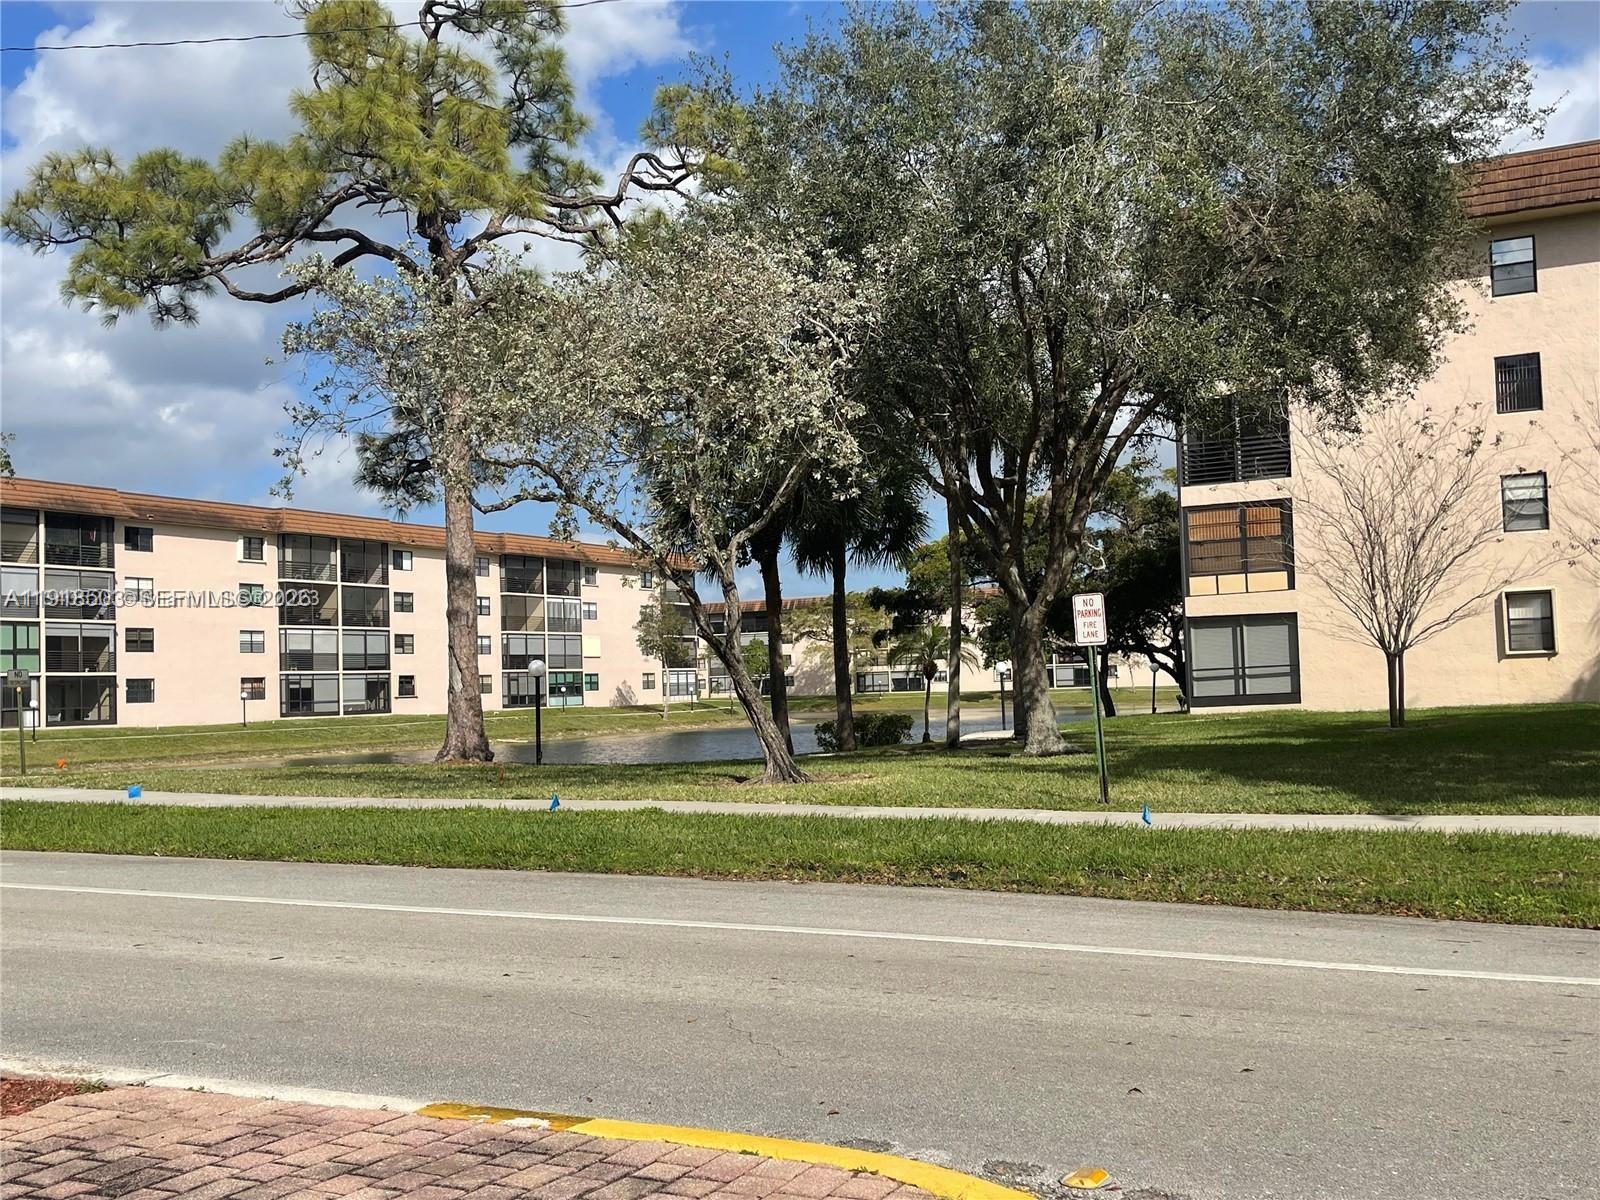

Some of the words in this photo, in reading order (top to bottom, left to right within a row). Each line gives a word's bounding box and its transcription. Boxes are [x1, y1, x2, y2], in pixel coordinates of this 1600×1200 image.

[1083, 598, 1094, 607] NO
[1077, 608, 1101, 618] PARKING
[1083, 621, 1096, 629] FIRE
